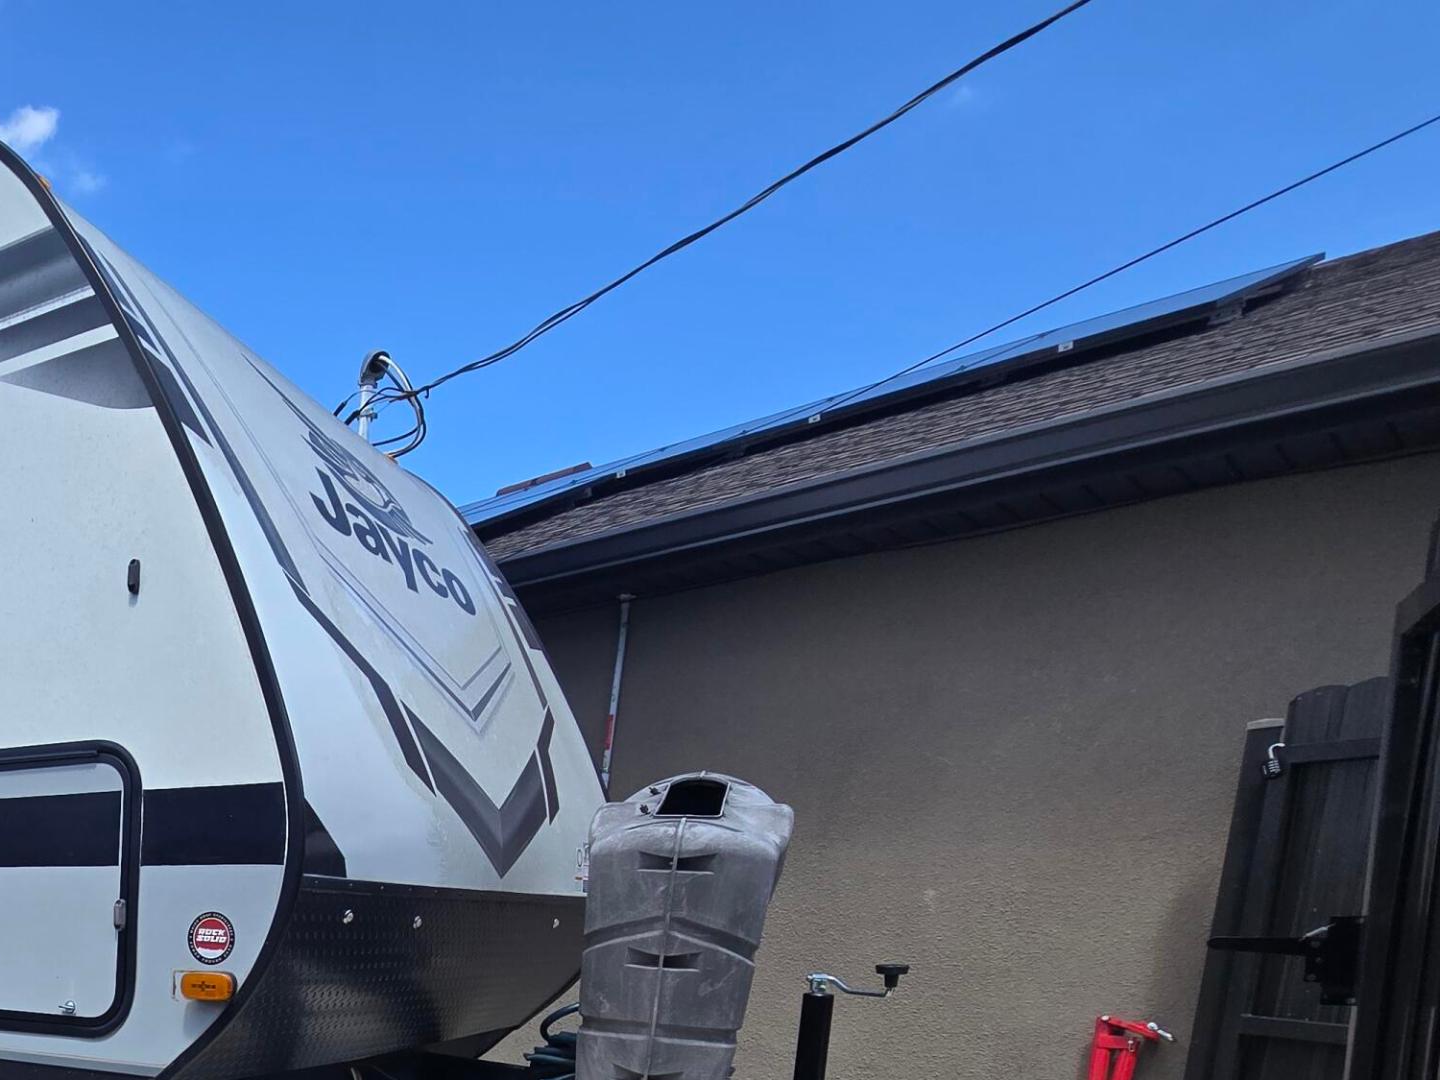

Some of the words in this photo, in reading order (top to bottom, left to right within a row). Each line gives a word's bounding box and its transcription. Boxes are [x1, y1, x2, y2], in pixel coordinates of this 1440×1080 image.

[309, 466, 476, 616] Jayco
[198, 928, 226, 937] ROCK
[196, 935, 228, 943] SOLID
